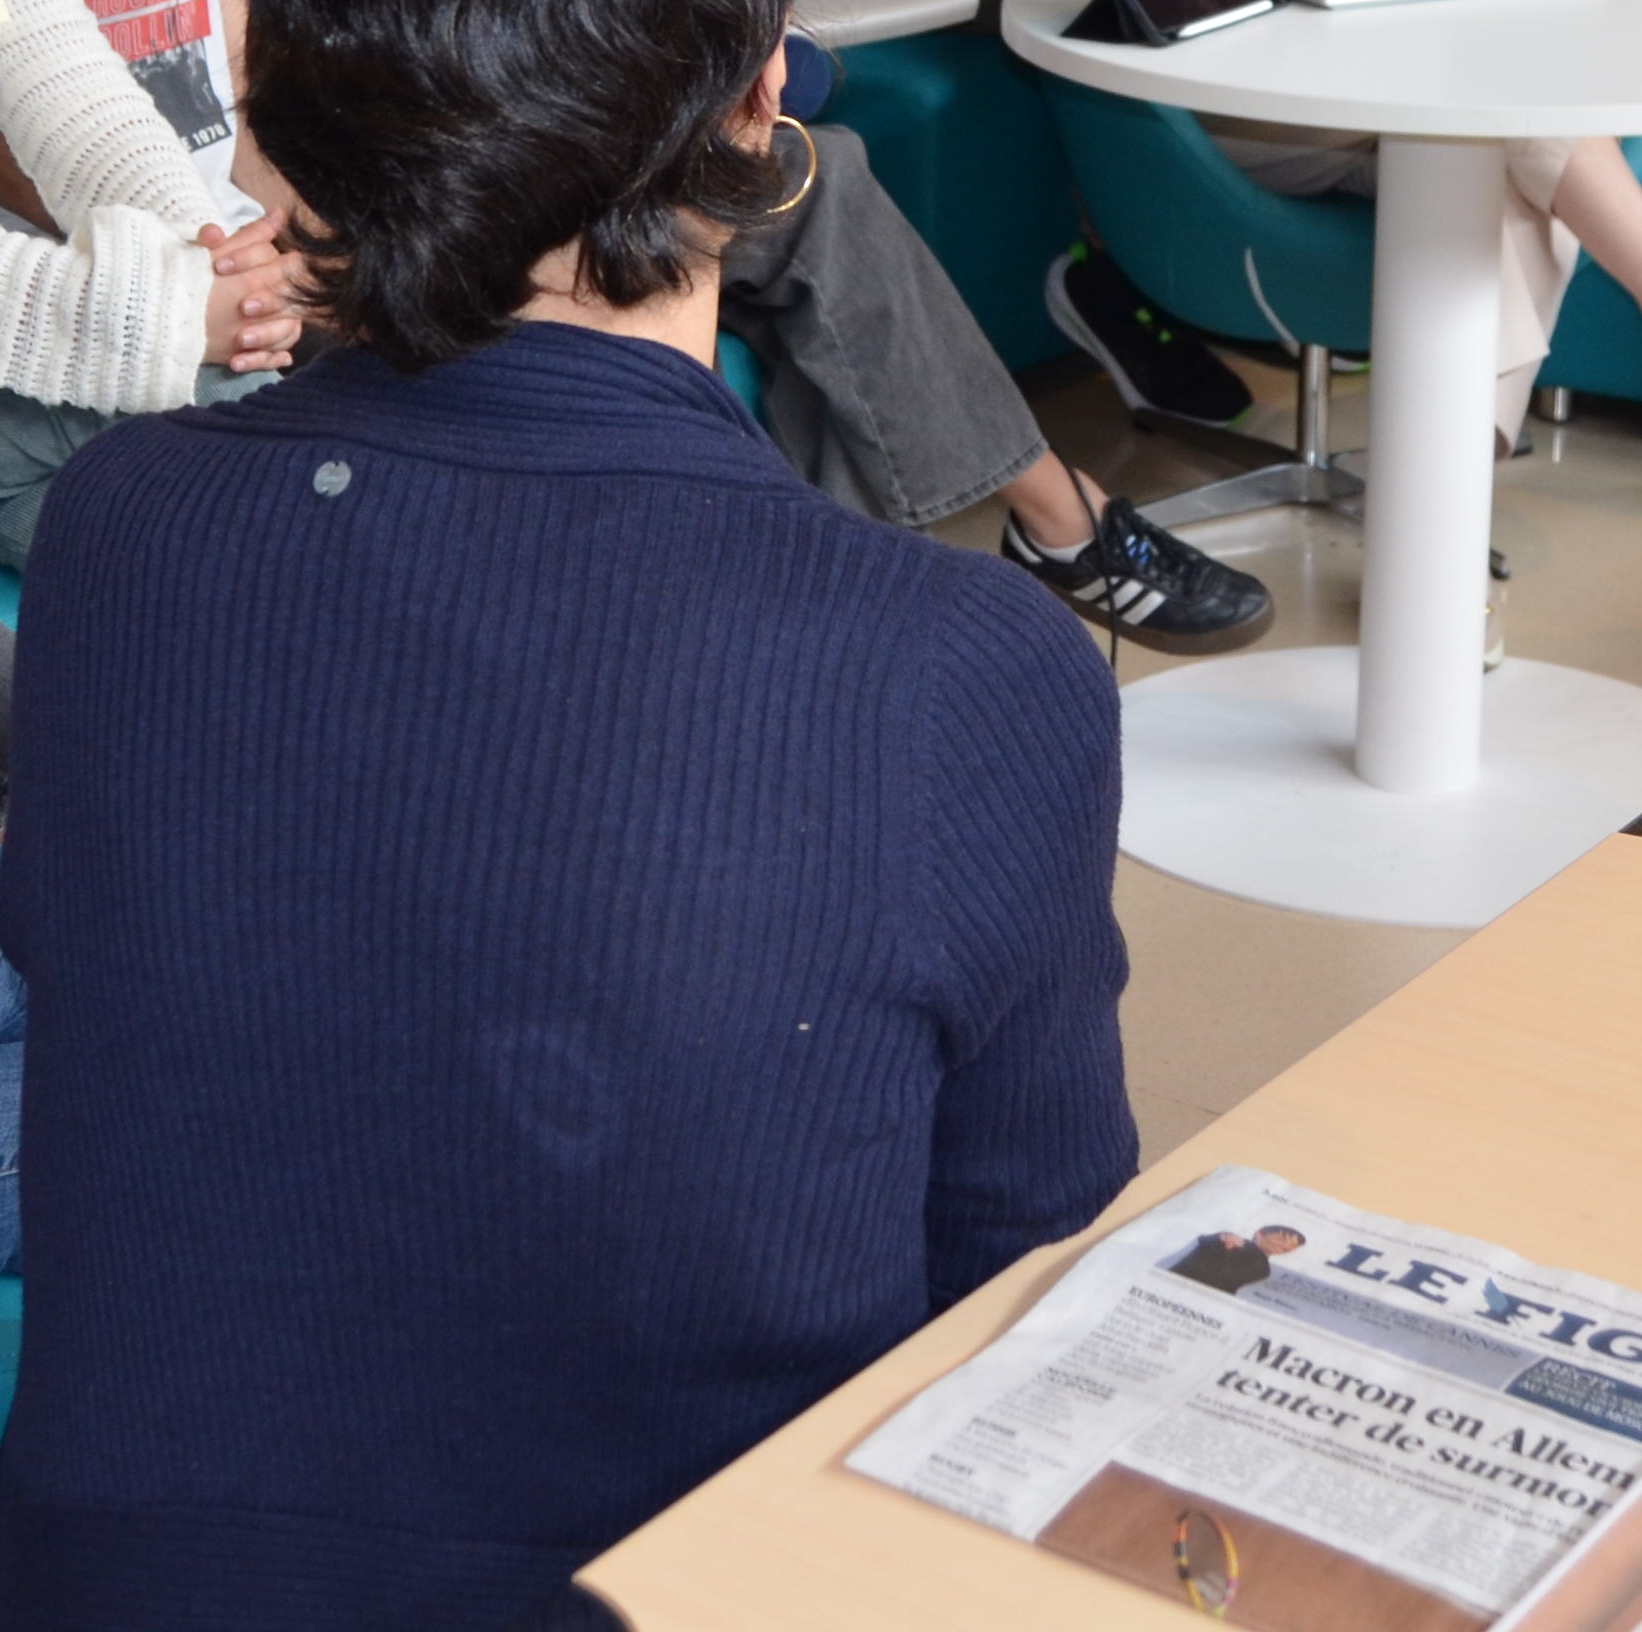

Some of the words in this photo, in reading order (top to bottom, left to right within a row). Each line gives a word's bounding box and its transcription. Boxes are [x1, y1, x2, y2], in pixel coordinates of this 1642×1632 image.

[1324, 1242, 1469, 1306] LE
[1214, 1366, 1361, 1433] tenter
[1364, 1419, 1425, 1456] de
[1240, 1336, 1418, 1416] Macron
[1425, 1404, 1485, 1440] en
[1490, 1426, 1636, 1491] Allem
